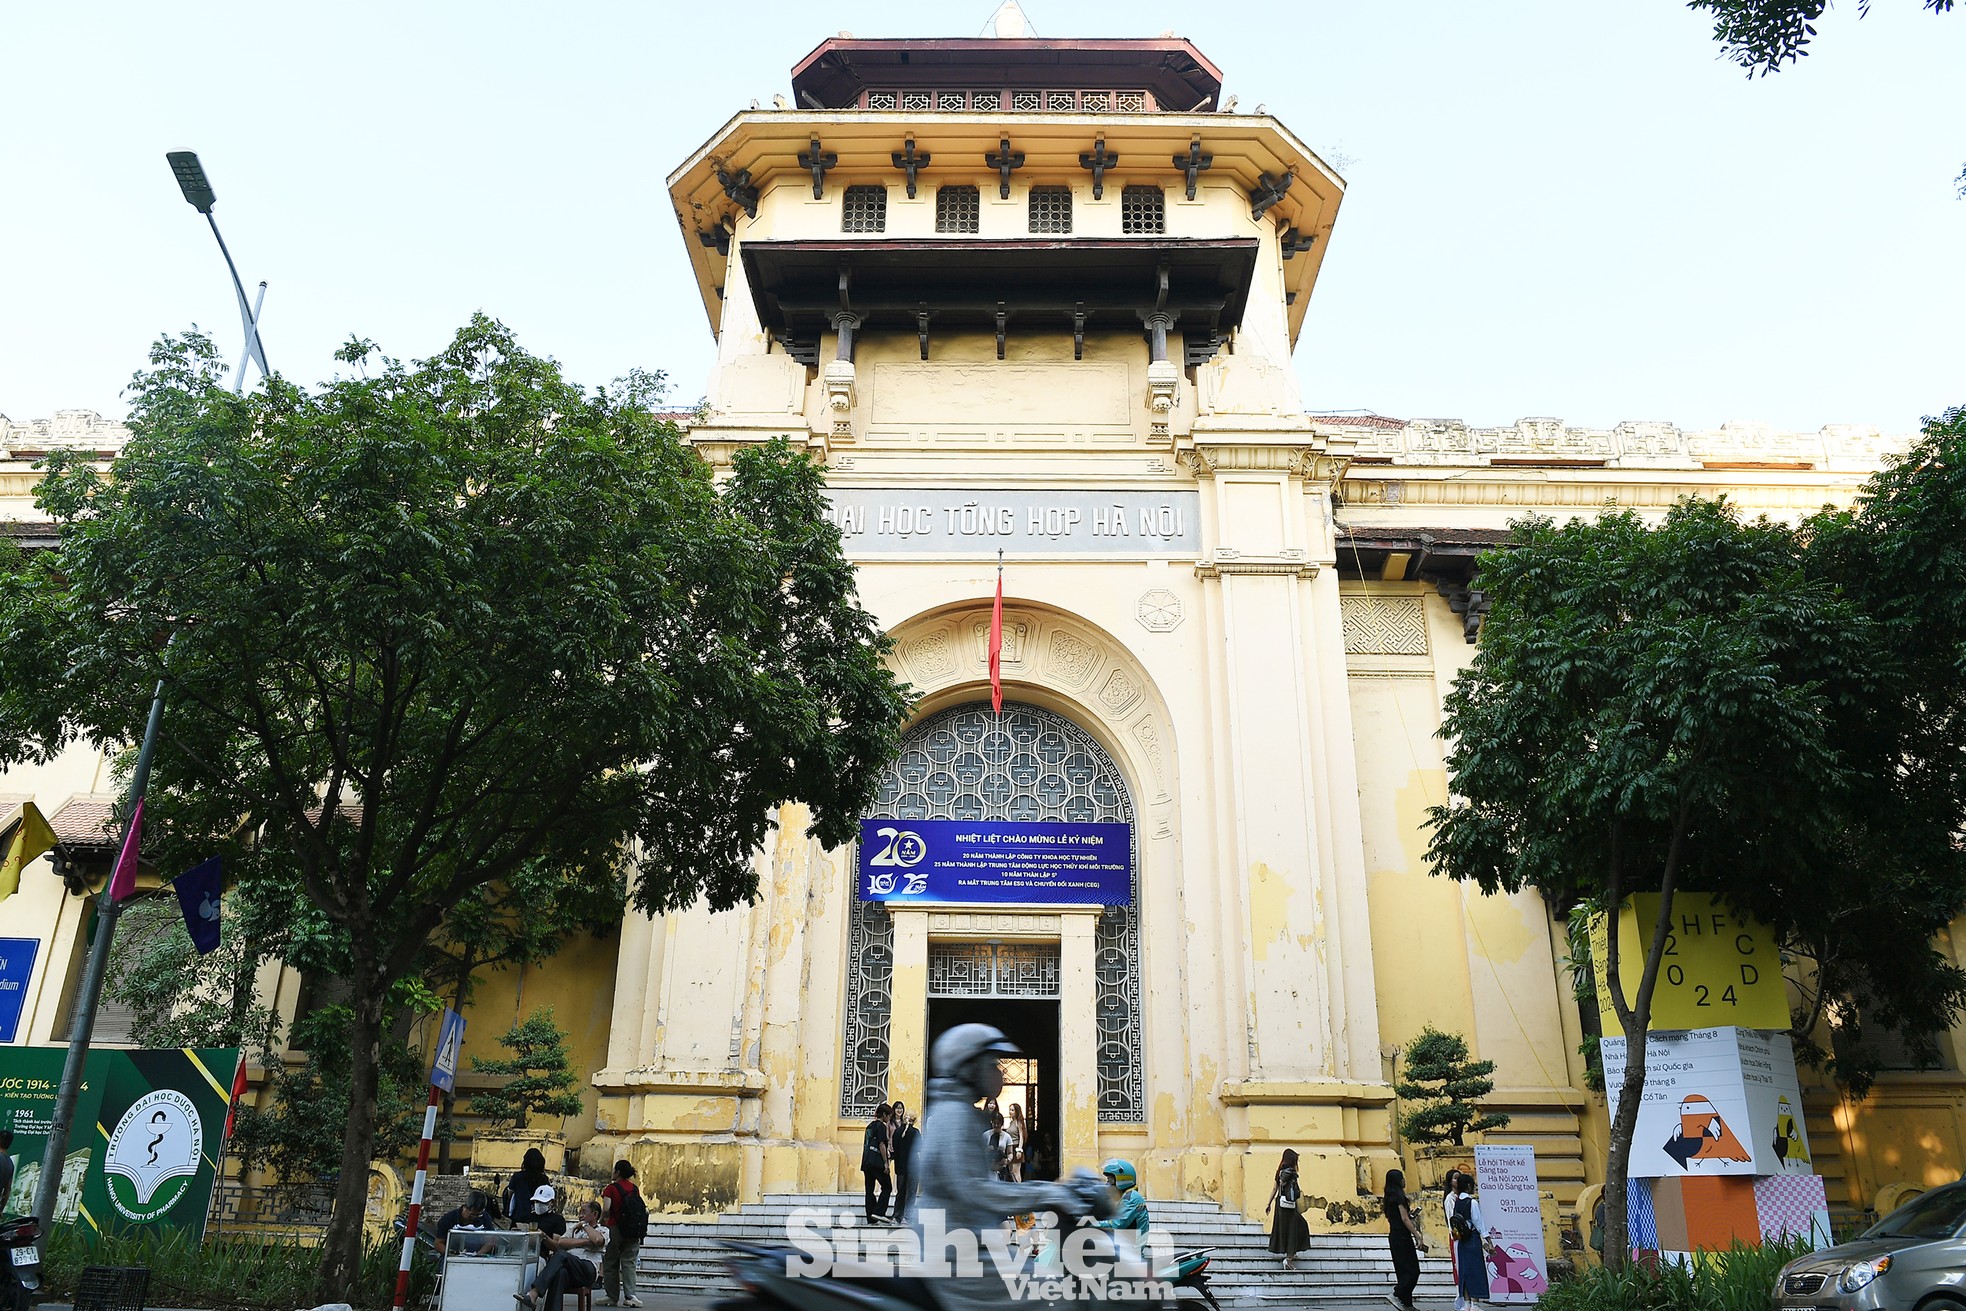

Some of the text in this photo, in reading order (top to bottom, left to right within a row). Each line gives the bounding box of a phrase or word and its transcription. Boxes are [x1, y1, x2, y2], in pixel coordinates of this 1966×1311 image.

[878, 505, 932, 538] HỌC
[944, 500, 1014, 536] TỔNG
[1027, 506, 1082, 540] HỢP
[1092, 504, 1130, 537] HÀ
[1138, 505, 1184, 541] NỘI
[956, 832, 1104, 846] NHIỆT LIỆT CHÀO MỪNG LỄ KỶ NIỆM
[870, 827, 927, 868] 20
[1649, 1035, 1668, 1043] Cách
[1669, 1034, 1689, 1042] mạng
[1658, 1049, 1670, 1057] Nội
[26, 1080, 50, 1090] 1914
[15, 1109, 34, 1118] 1961
[1479, 1166, 1496, 1174] Sáng
[1505, 1183, 1522, 1191] Sáng
[106, 1177, 188, 1220] HANOI UNIVERSITY OF PHARMACY
